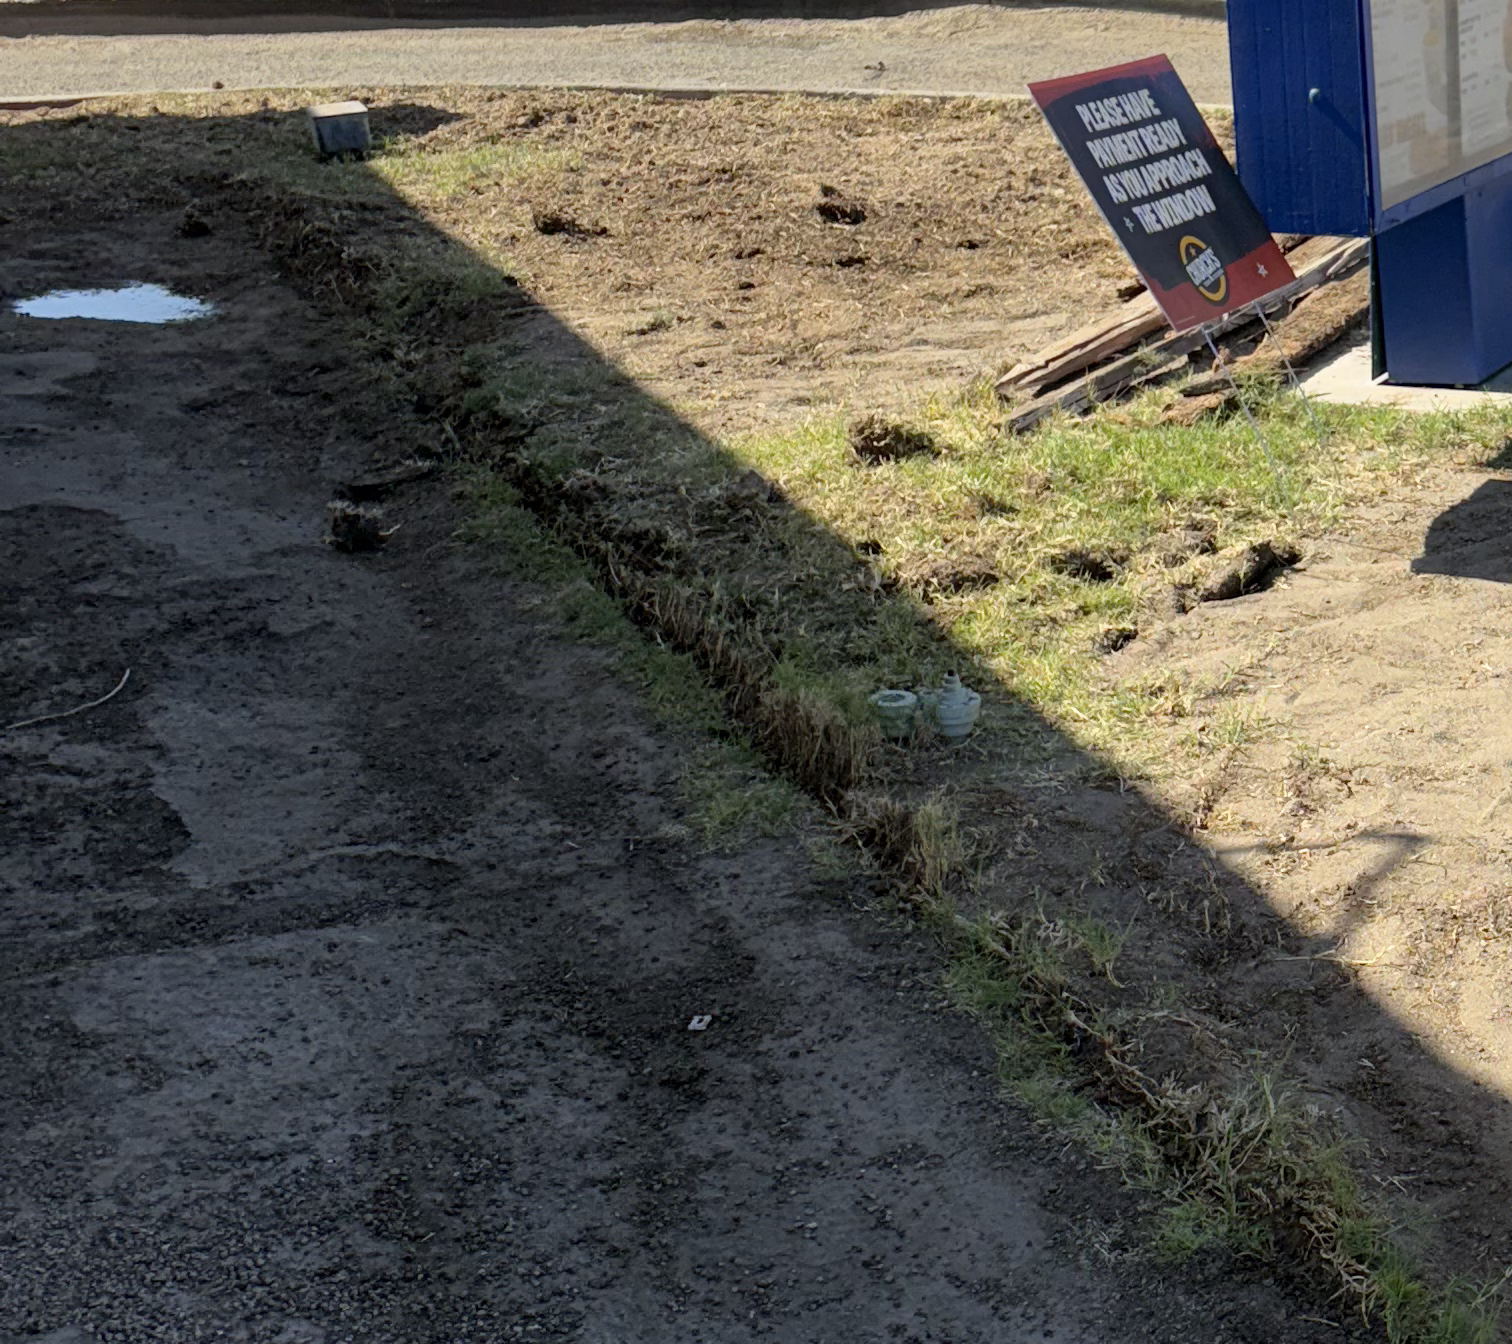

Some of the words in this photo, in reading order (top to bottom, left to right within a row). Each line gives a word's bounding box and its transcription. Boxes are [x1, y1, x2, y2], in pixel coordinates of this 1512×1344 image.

[1075, 96, 1129, 133] PLEASE
[1118, 88, 1162, 123] HAVE
[1085, 129, 1148, 169] PAYMENT
[1137, 117, 1188, 156] READY
[1102, 173, 1129, 204] AS
[1116, 166, 1149, 200] YOU
[1139, 147, 1212, 195] APPROACH
[1131, 200, 1163, 235] THE
[1151, 184, 1216, 230] WINDOW
